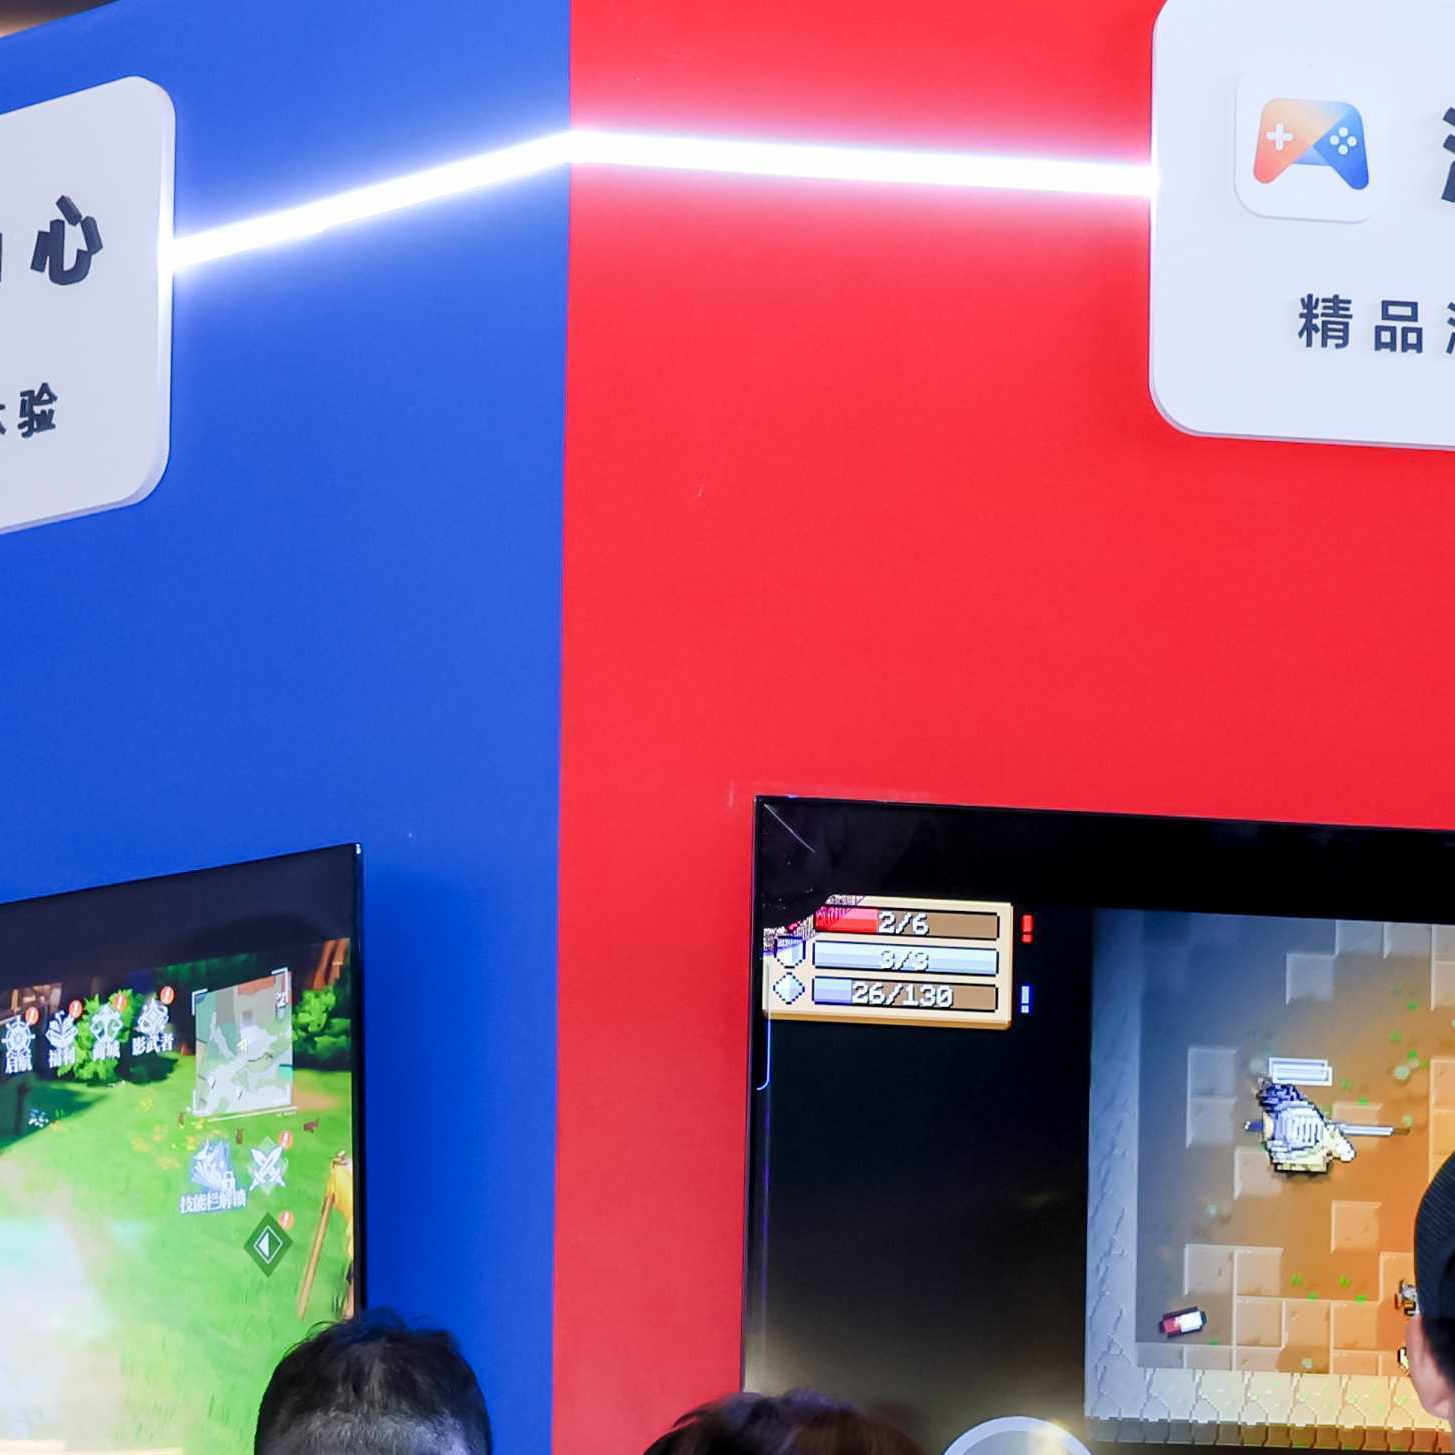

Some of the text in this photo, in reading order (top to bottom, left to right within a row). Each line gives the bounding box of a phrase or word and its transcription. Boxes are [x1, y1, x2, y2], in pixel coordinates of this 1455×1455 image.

[878, 912, 930, 935] 2/6
[879, 950, 930, 971] 3/3
[851, 982, 954, 1008] 26/130
